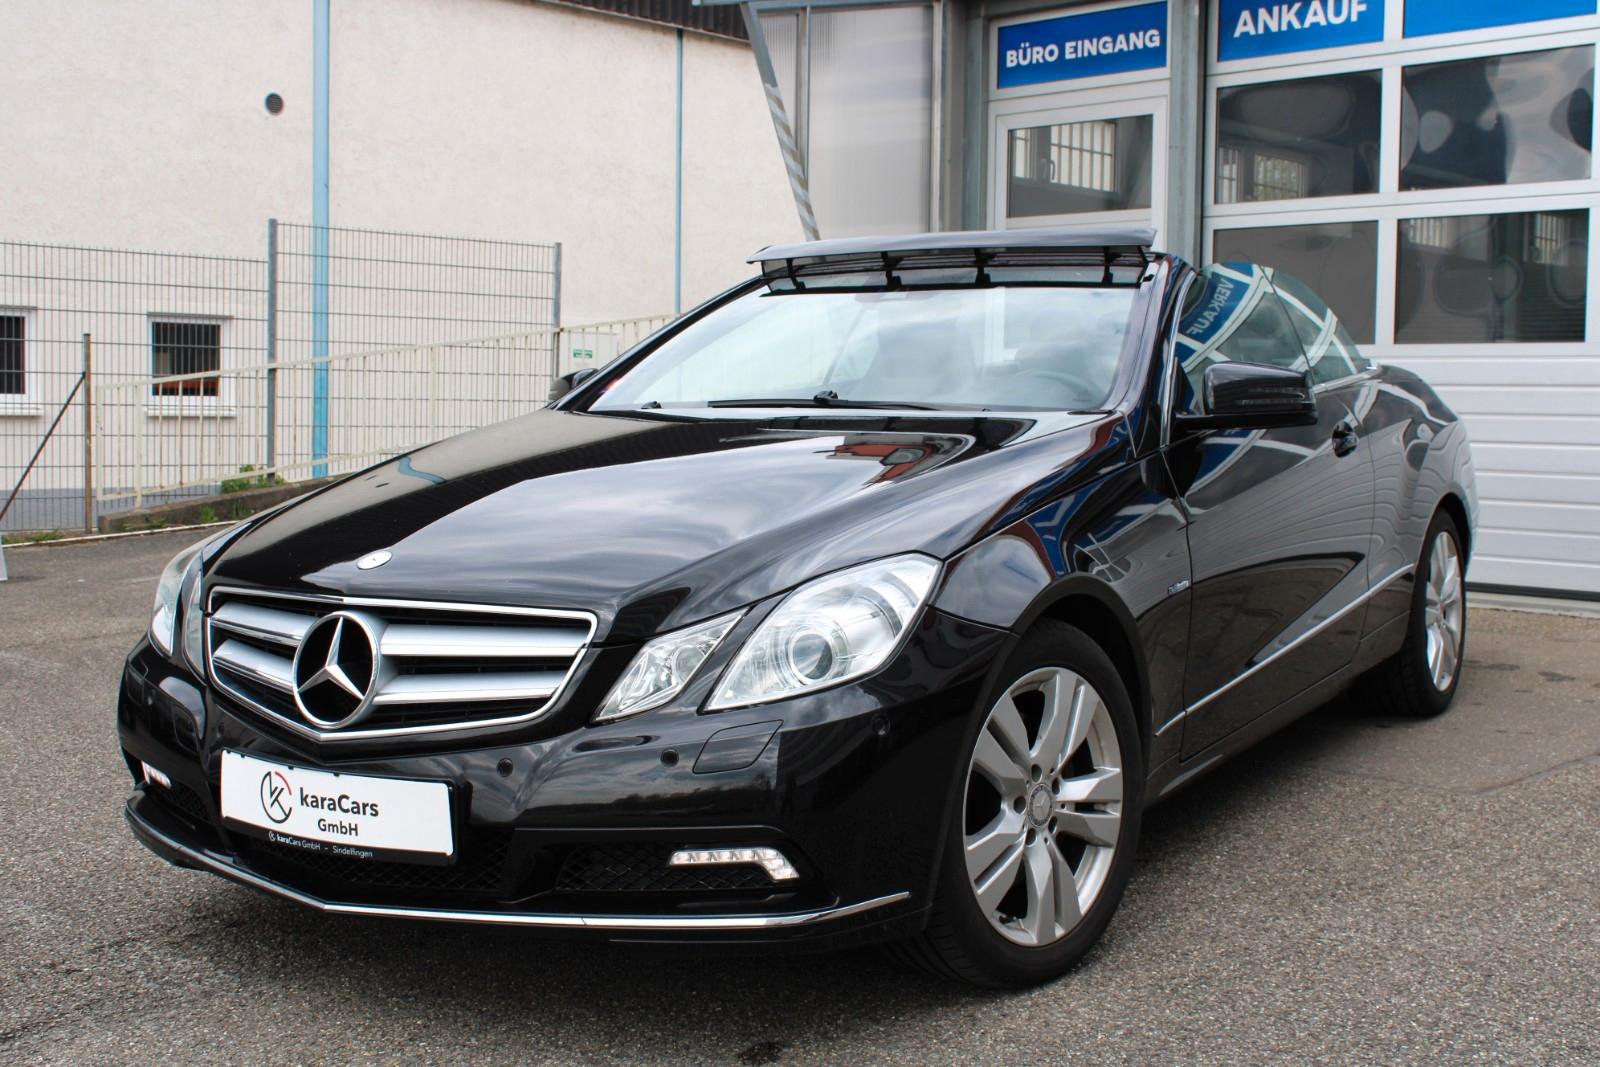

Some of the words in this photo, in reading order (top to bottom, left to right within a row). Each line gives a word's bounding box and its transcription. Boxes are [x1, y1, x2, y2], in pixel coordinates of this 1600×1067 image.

[1233, 0, 1368, 38] ANKAUF
[1005, 43, 1059, 68] BÜRO
[1065, 29, 1161, 60] EINGANG
[299, 786, 380, 817] karaCars
[317, 818, 359, 836] GmbH
